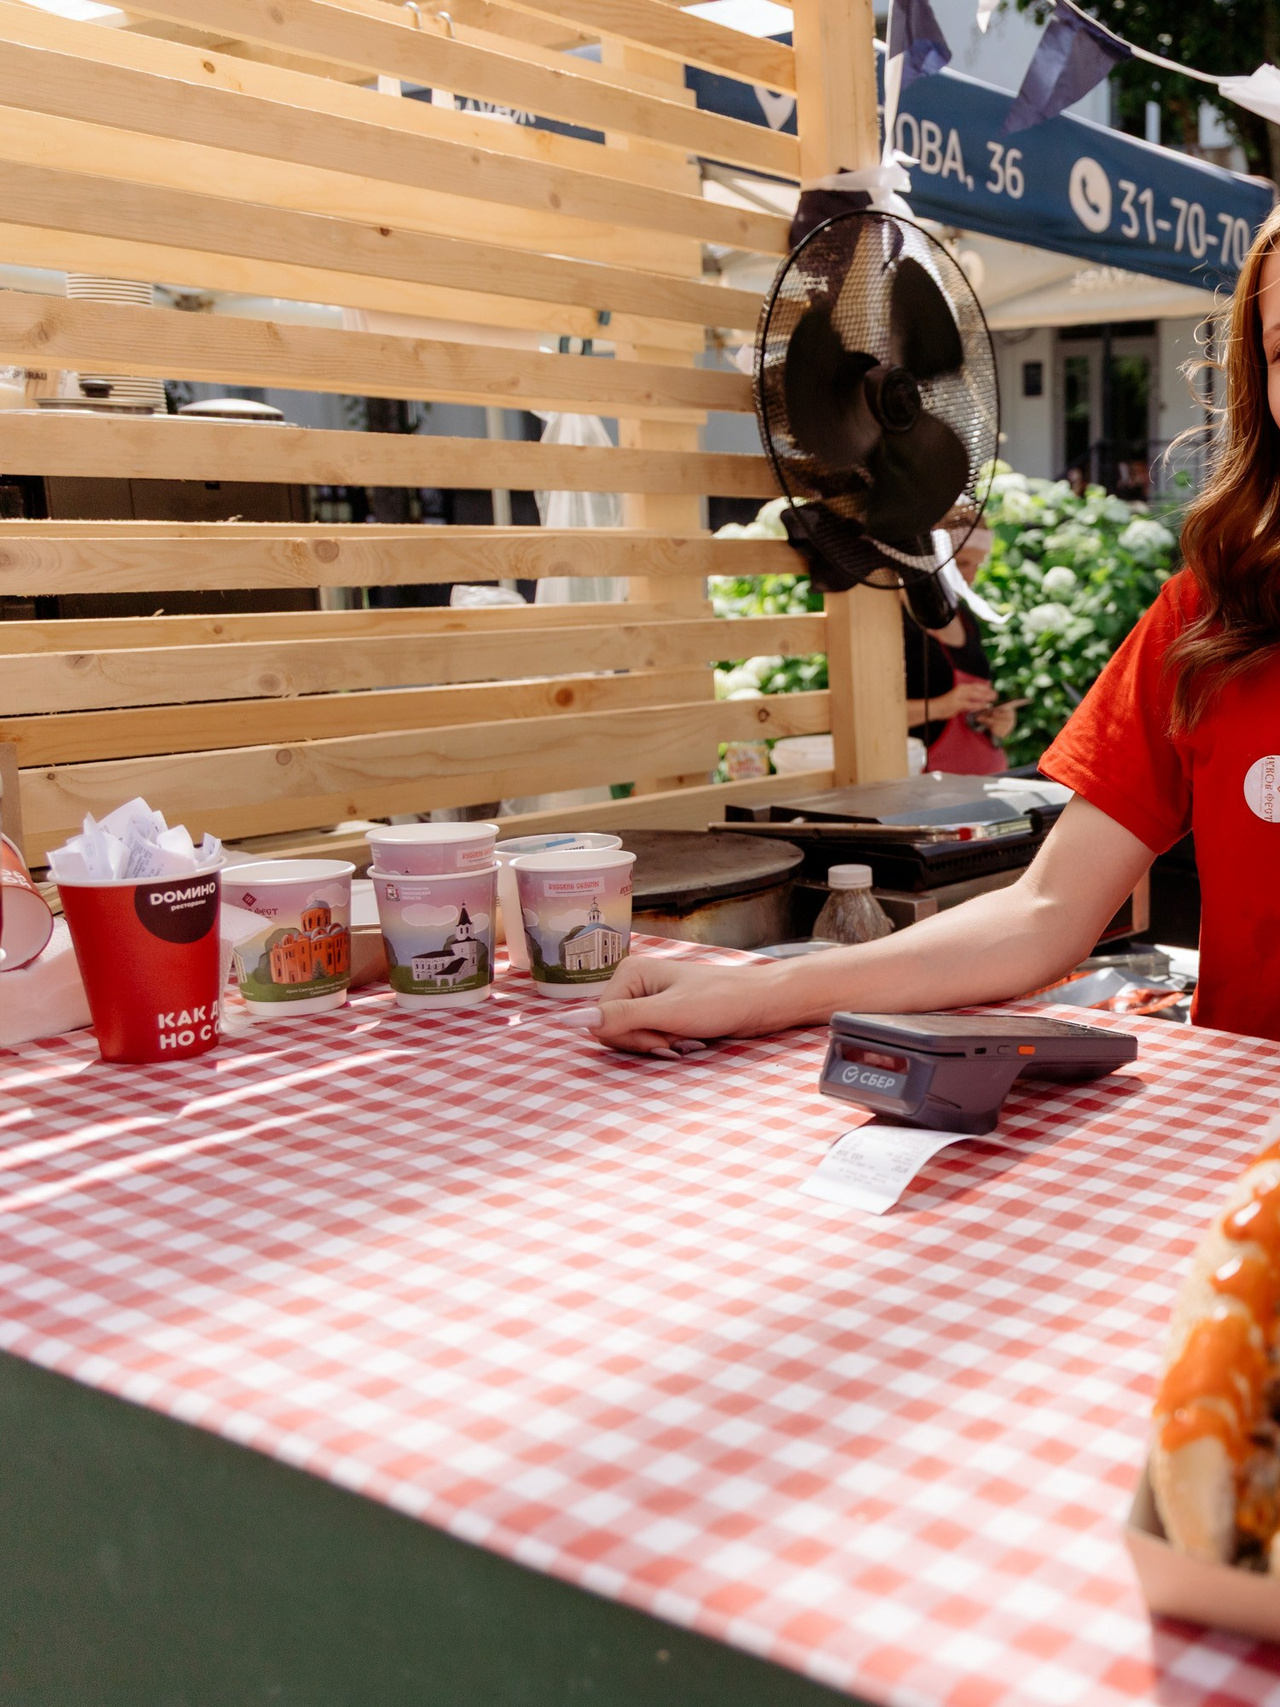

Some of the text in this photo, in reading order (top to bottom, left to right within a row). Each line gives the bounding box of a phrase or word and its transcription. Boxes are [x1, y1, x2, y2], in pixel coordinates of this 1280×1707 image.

[986, 141, 1025, 200] 36
[1118, 179, 1250, 271] 31-70-70
[171, 899, 206, 912] рестораны
[158, 1005, 206, 1029] КАК
[160, 1030, 195, 1050] НО
[860, 1072, 895, 1089] СБЕР
